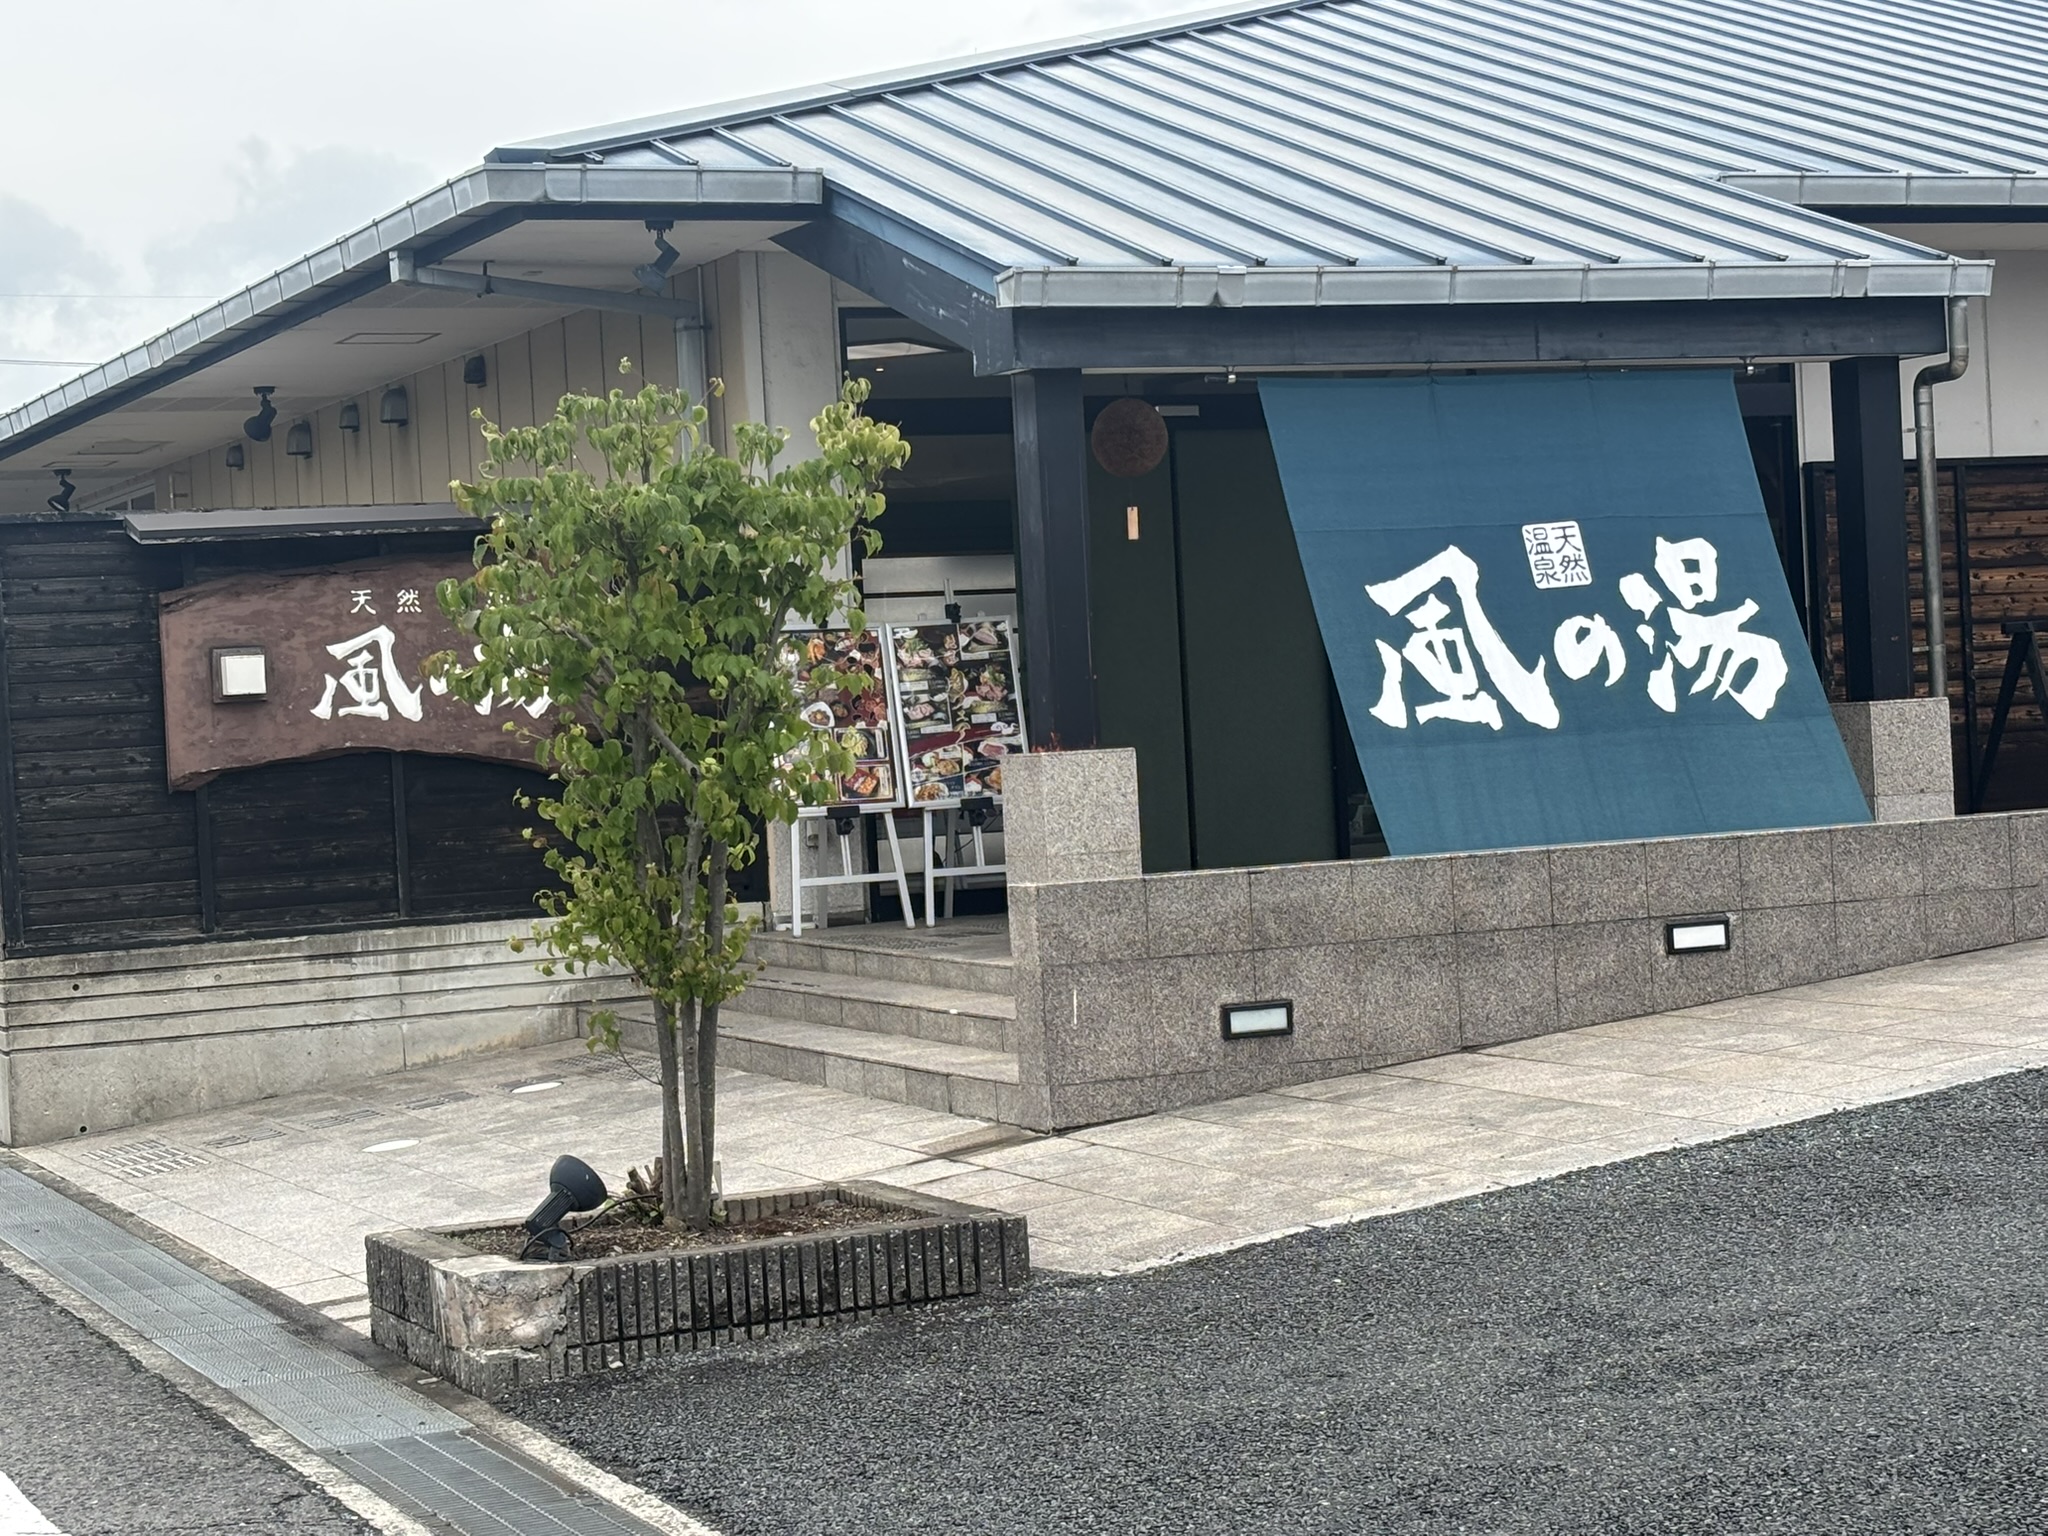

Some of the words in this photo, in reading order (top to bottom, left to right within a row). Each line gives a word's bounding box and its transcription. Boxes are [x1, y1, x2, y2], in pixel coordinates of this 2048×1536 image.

[1524, 526, 1562, 584] 温泉
[1550, 525, 1588, 583] 天然
[1364, 536, 1788, 730] 風の湯
